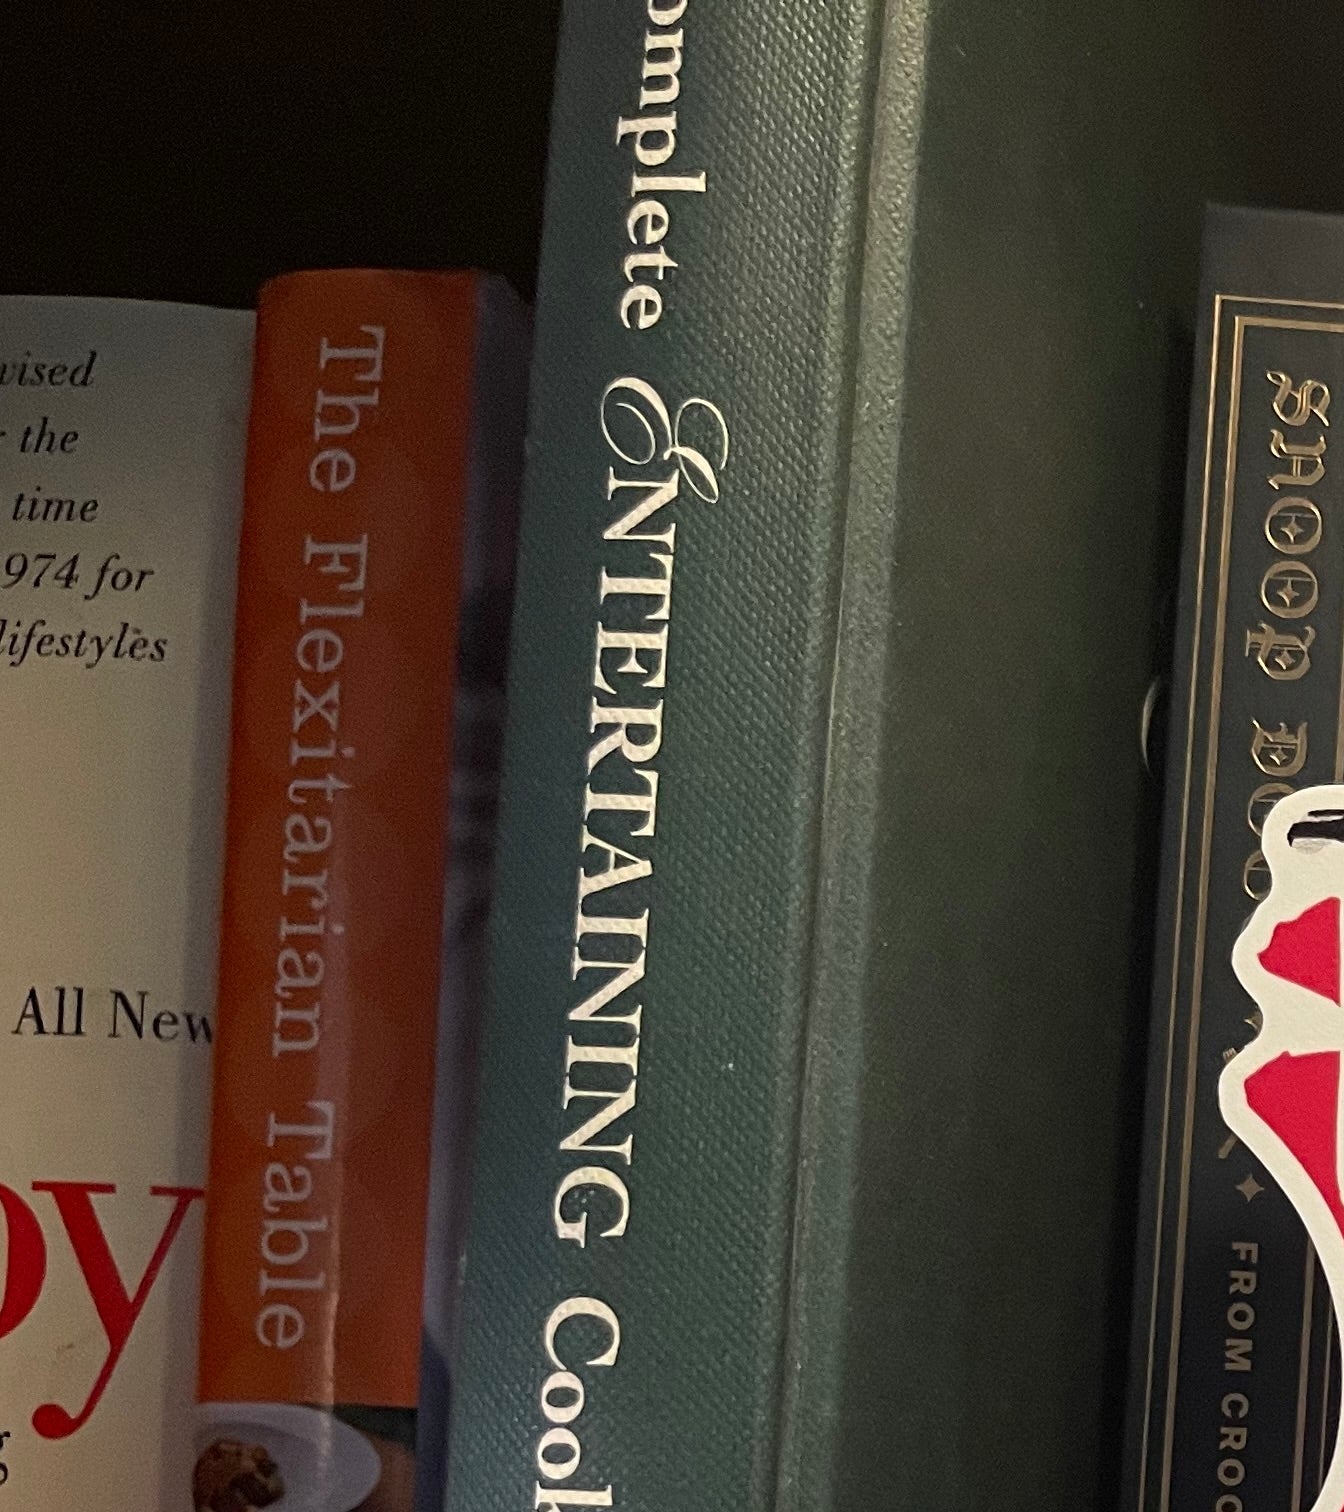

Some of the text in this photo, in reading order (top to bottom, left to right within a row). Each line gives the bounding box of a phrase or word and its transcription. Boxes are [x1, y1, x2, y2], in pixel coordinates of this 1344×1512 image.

[19, 416, 80, 455] the
[11, 485, 99, 523] time
[84, 552, 155, 601] for
[254, 325, 387, 1350] The Flexitarian Table
[552, 376, 729, 1249] ENTERTAINING
[11, 985, 86, 1037] All
[1224, 1240, 1259, 1372] FROM
